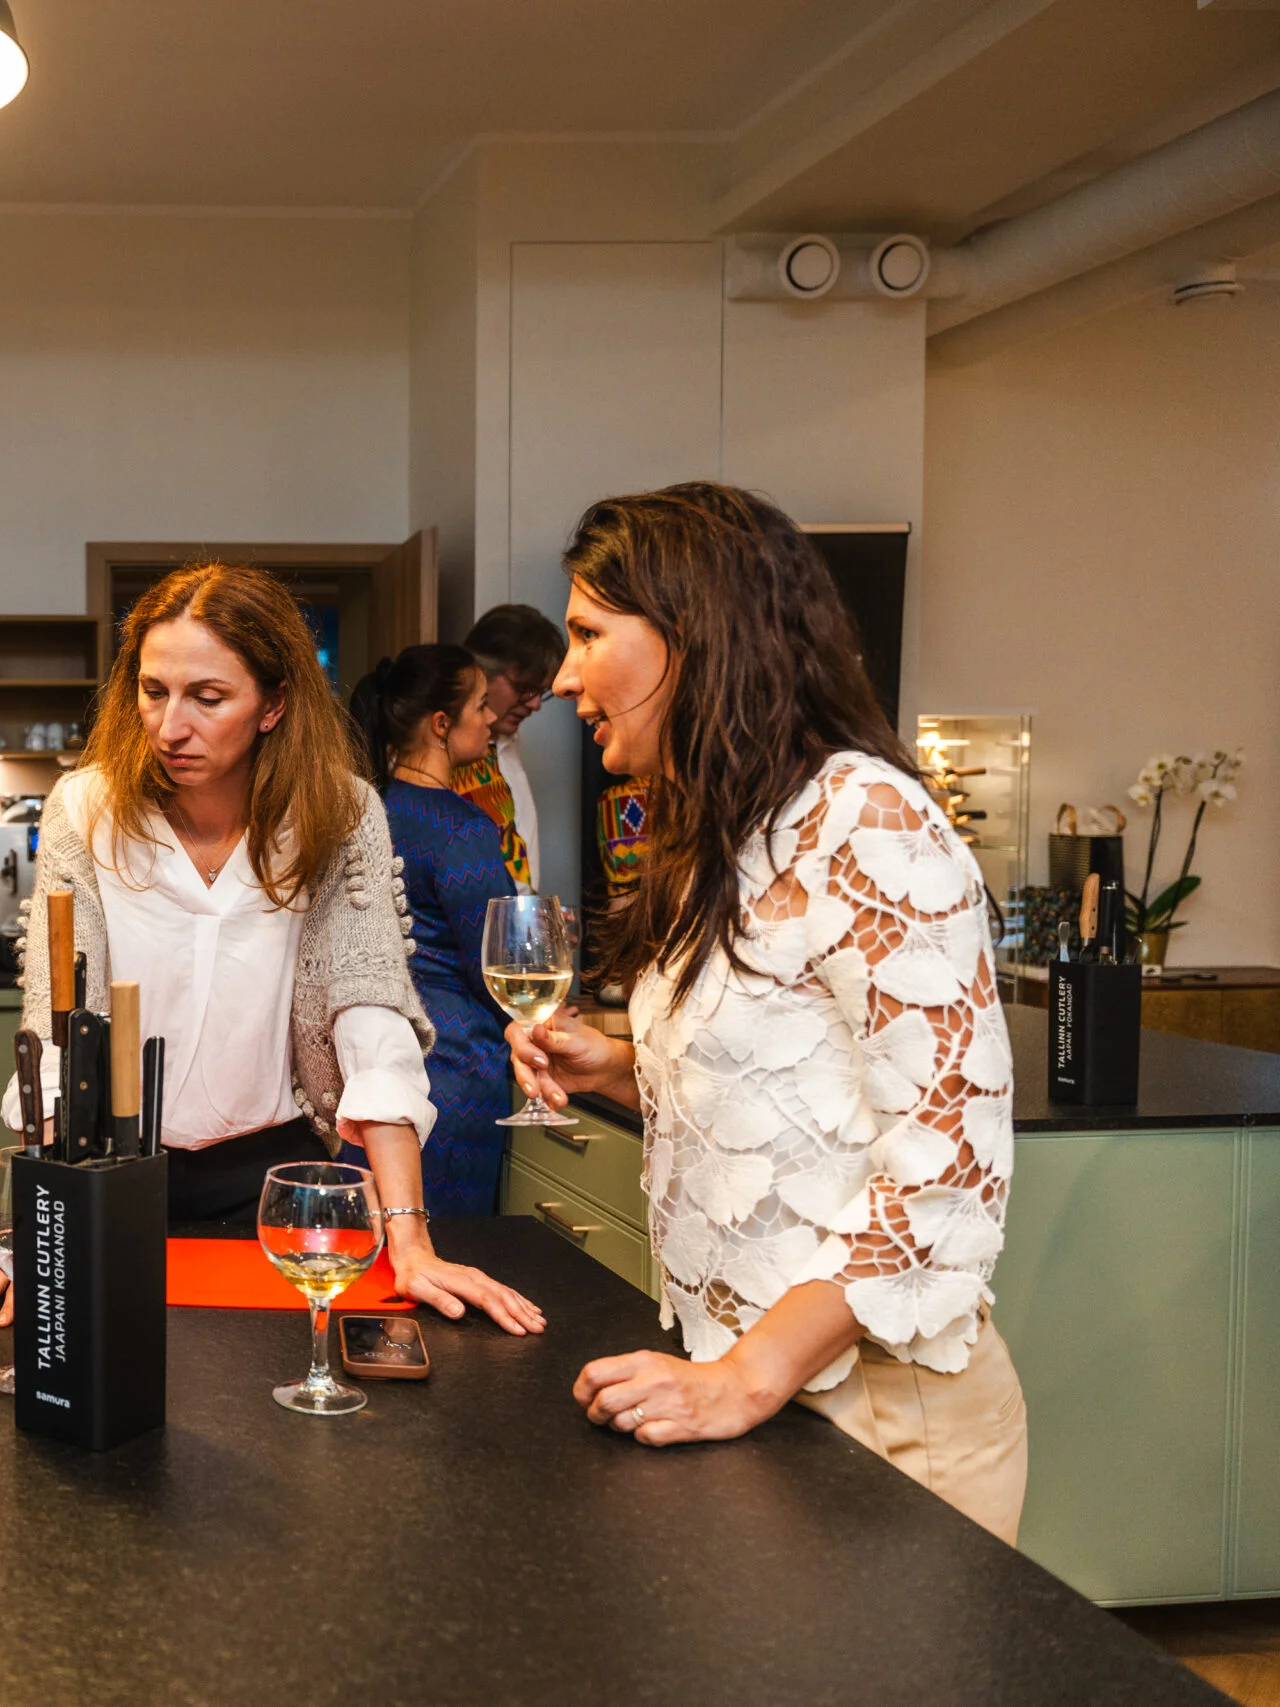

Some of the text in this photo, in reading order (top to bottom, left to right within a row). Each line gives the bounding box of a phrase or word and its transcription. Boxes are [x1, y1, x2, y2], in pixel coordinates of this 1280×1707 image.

[1058, 975, 1067, 1023] CUTLERY
[1058, 1025, 1066, 1069] TALLINN
[36, 1184, 52, 1370] TALLINN CUTLERY
[53, 1200, 66, 1363] JAAPANI KOKANOAD
[35, 1390, 71, 1409] samura
